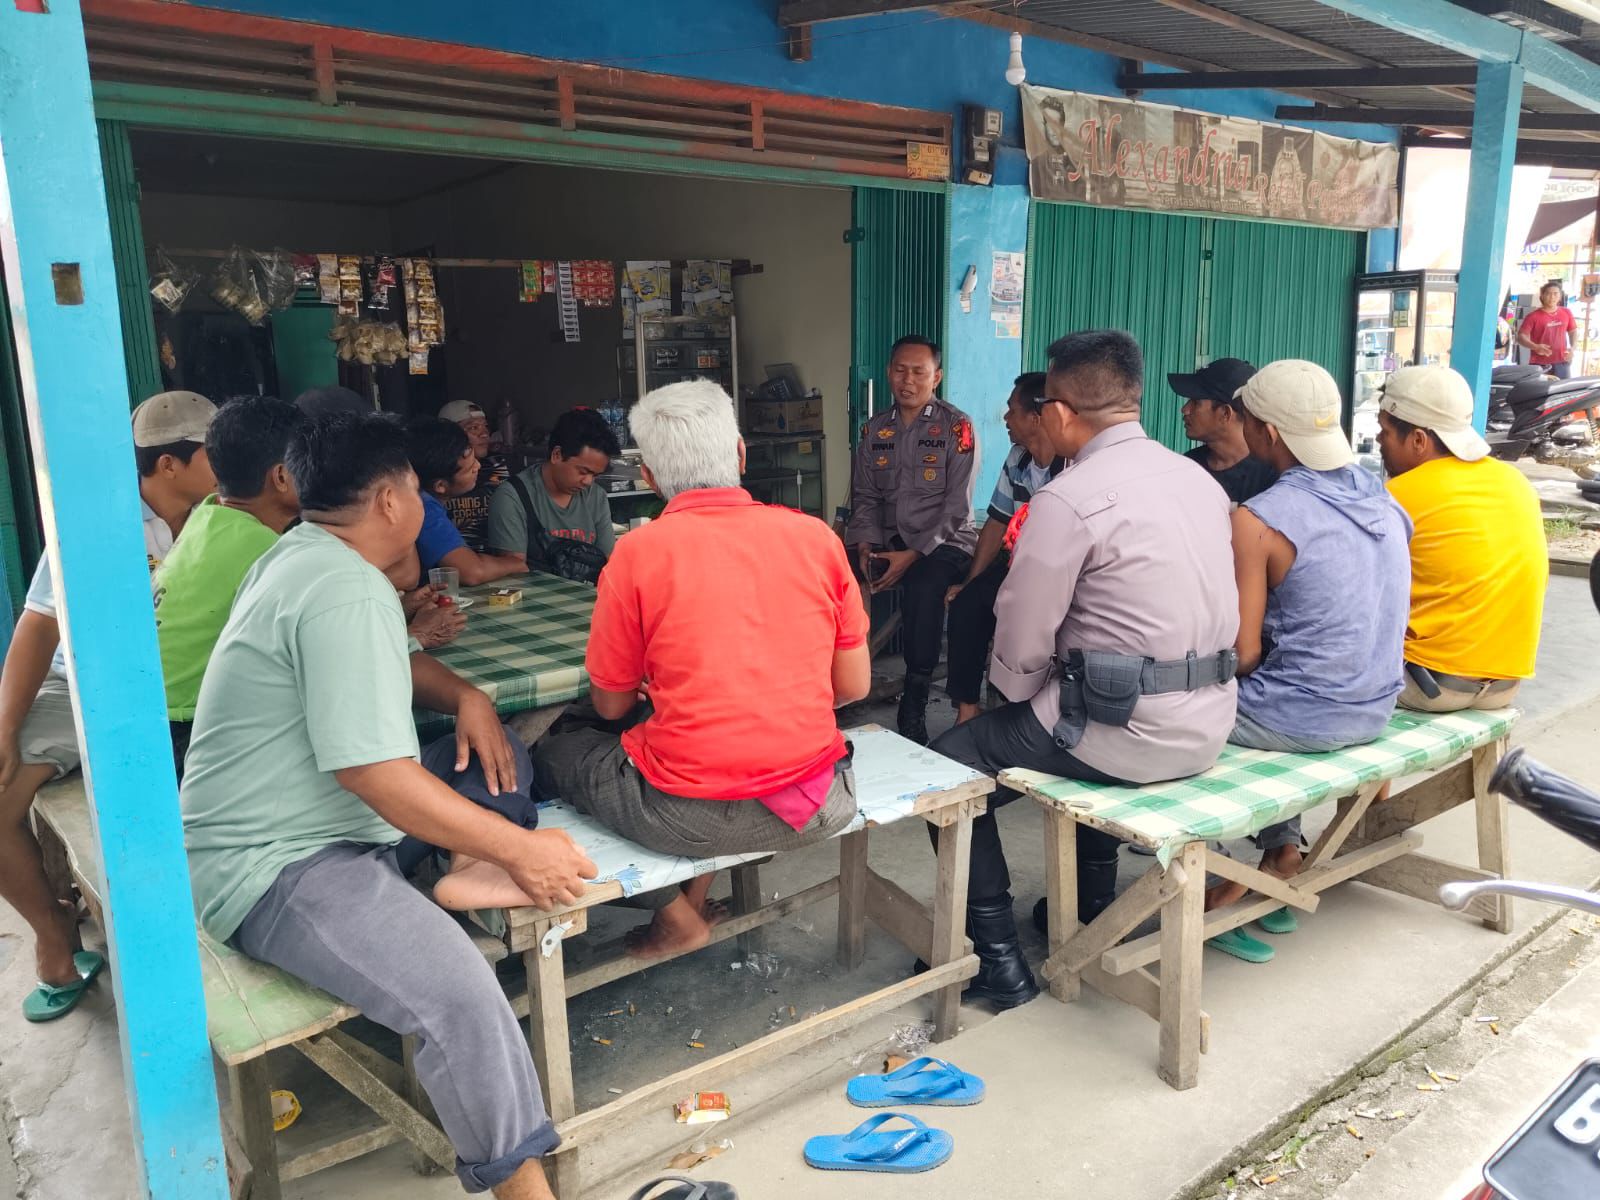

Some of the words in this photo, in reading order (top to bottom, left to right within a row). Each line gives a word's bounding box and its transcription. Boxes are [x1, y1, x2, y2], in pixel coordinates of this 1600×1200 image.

[1068, 113, 1250, 192] Alexandria
[918, 439, 946, 448] POLRI
[445, 496, 481, 510] OTHING
[453, 507, 489, 519] FOREVE
